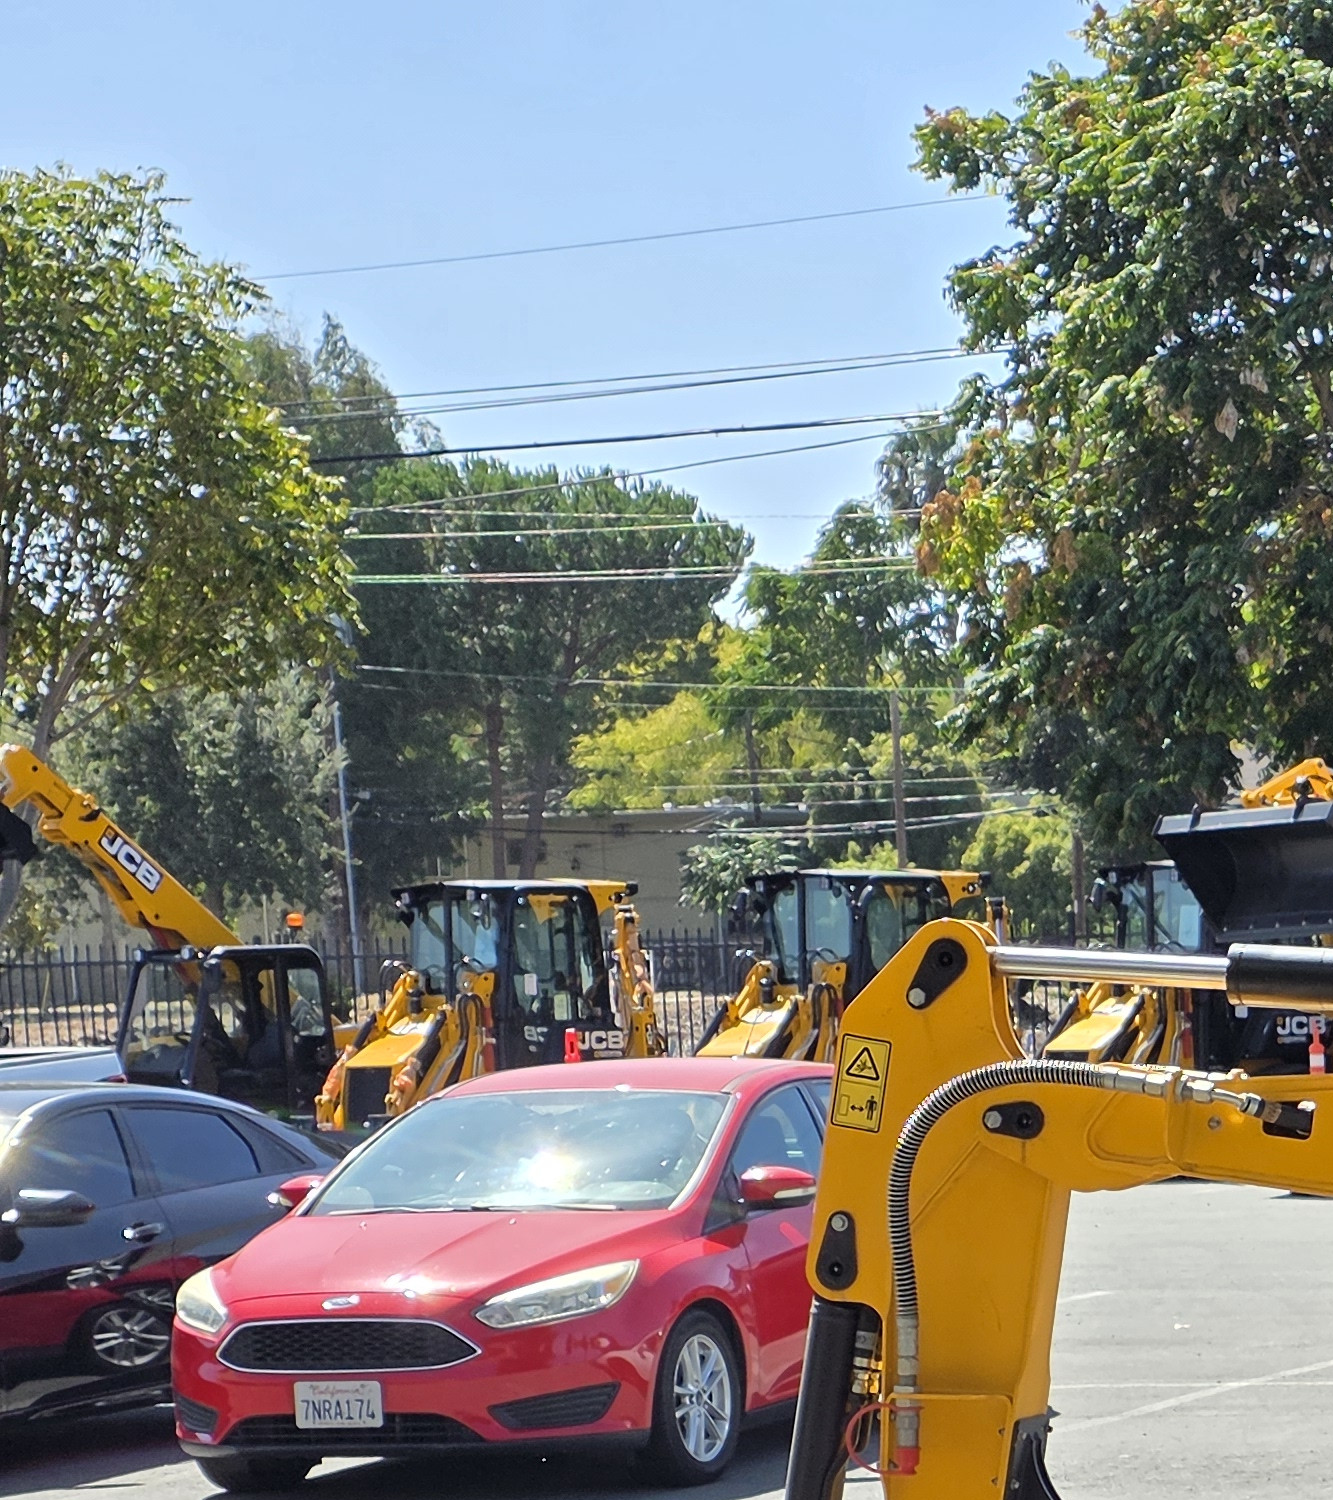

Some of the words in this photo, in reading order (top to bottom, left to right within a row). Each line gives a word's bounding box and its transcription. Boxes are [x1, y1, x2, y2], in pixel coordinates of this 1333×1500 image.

[101, 836, 161, 891] JCB
[1277, 1016, 1326, 1035] JCB
[577, 1031, 624, 1050] JCB
[300, 1400, 376, 1420] 7NRA174
